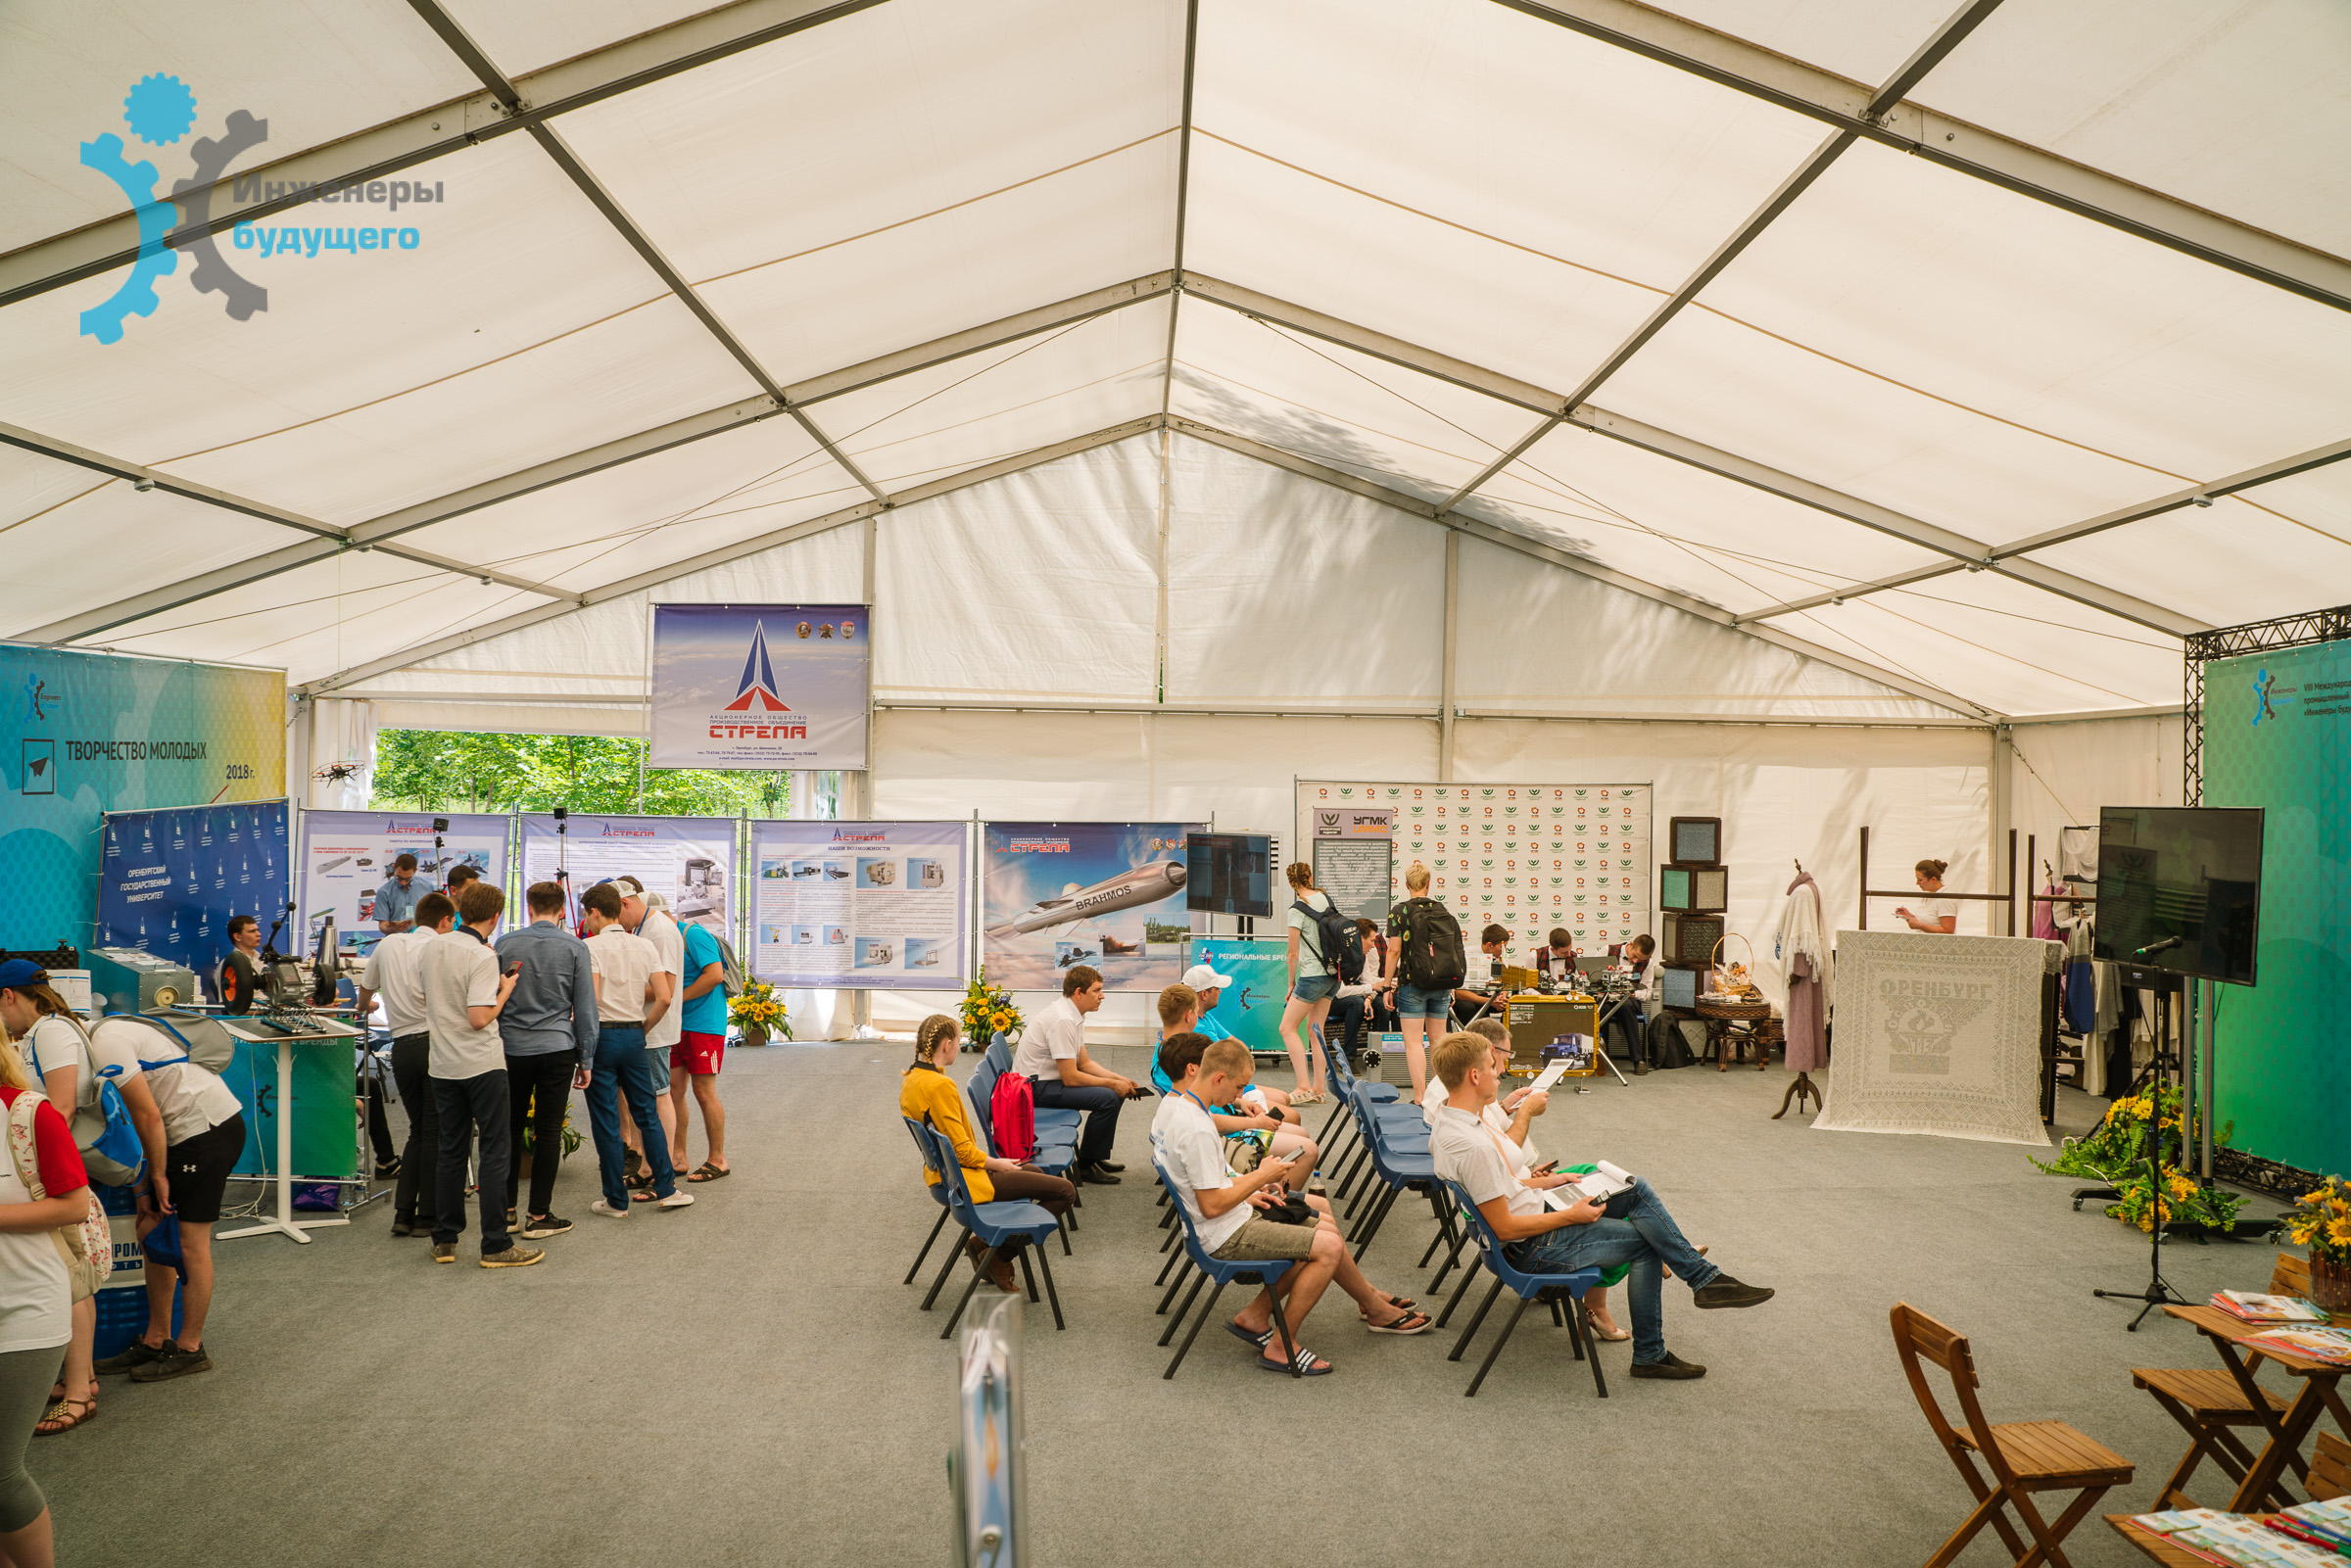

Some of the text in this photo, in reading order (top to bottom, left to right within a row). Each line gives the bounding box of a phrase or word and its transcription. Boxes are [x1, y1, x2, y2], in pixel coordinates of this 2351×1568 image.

[2304, 691, 2349, 705] промышленный
[709, 725, 807, 739] СТРЕЛА
[65, 740, 208, 763] ТВОРЧЕСТВО МОЛОДЫХ
[1353, 816, 1388, 825] УГМК
[1353, 825, 1388, 833] UMMC
[1010, 843, 1071, 853] СТРЕЛА
[127, 864, 167, 879] ОРЕНБУРГСКИЙ
[120, 877, 171, 892] ГОСУДАРСТВЕННЫЙ
[126, 890, 165, 904] УНИВЕРСИТЕТ
[1076, 884, 1132, 911] BRAHMOS
[1880, 979, 1992, 998] ОРЕНБУРГ
